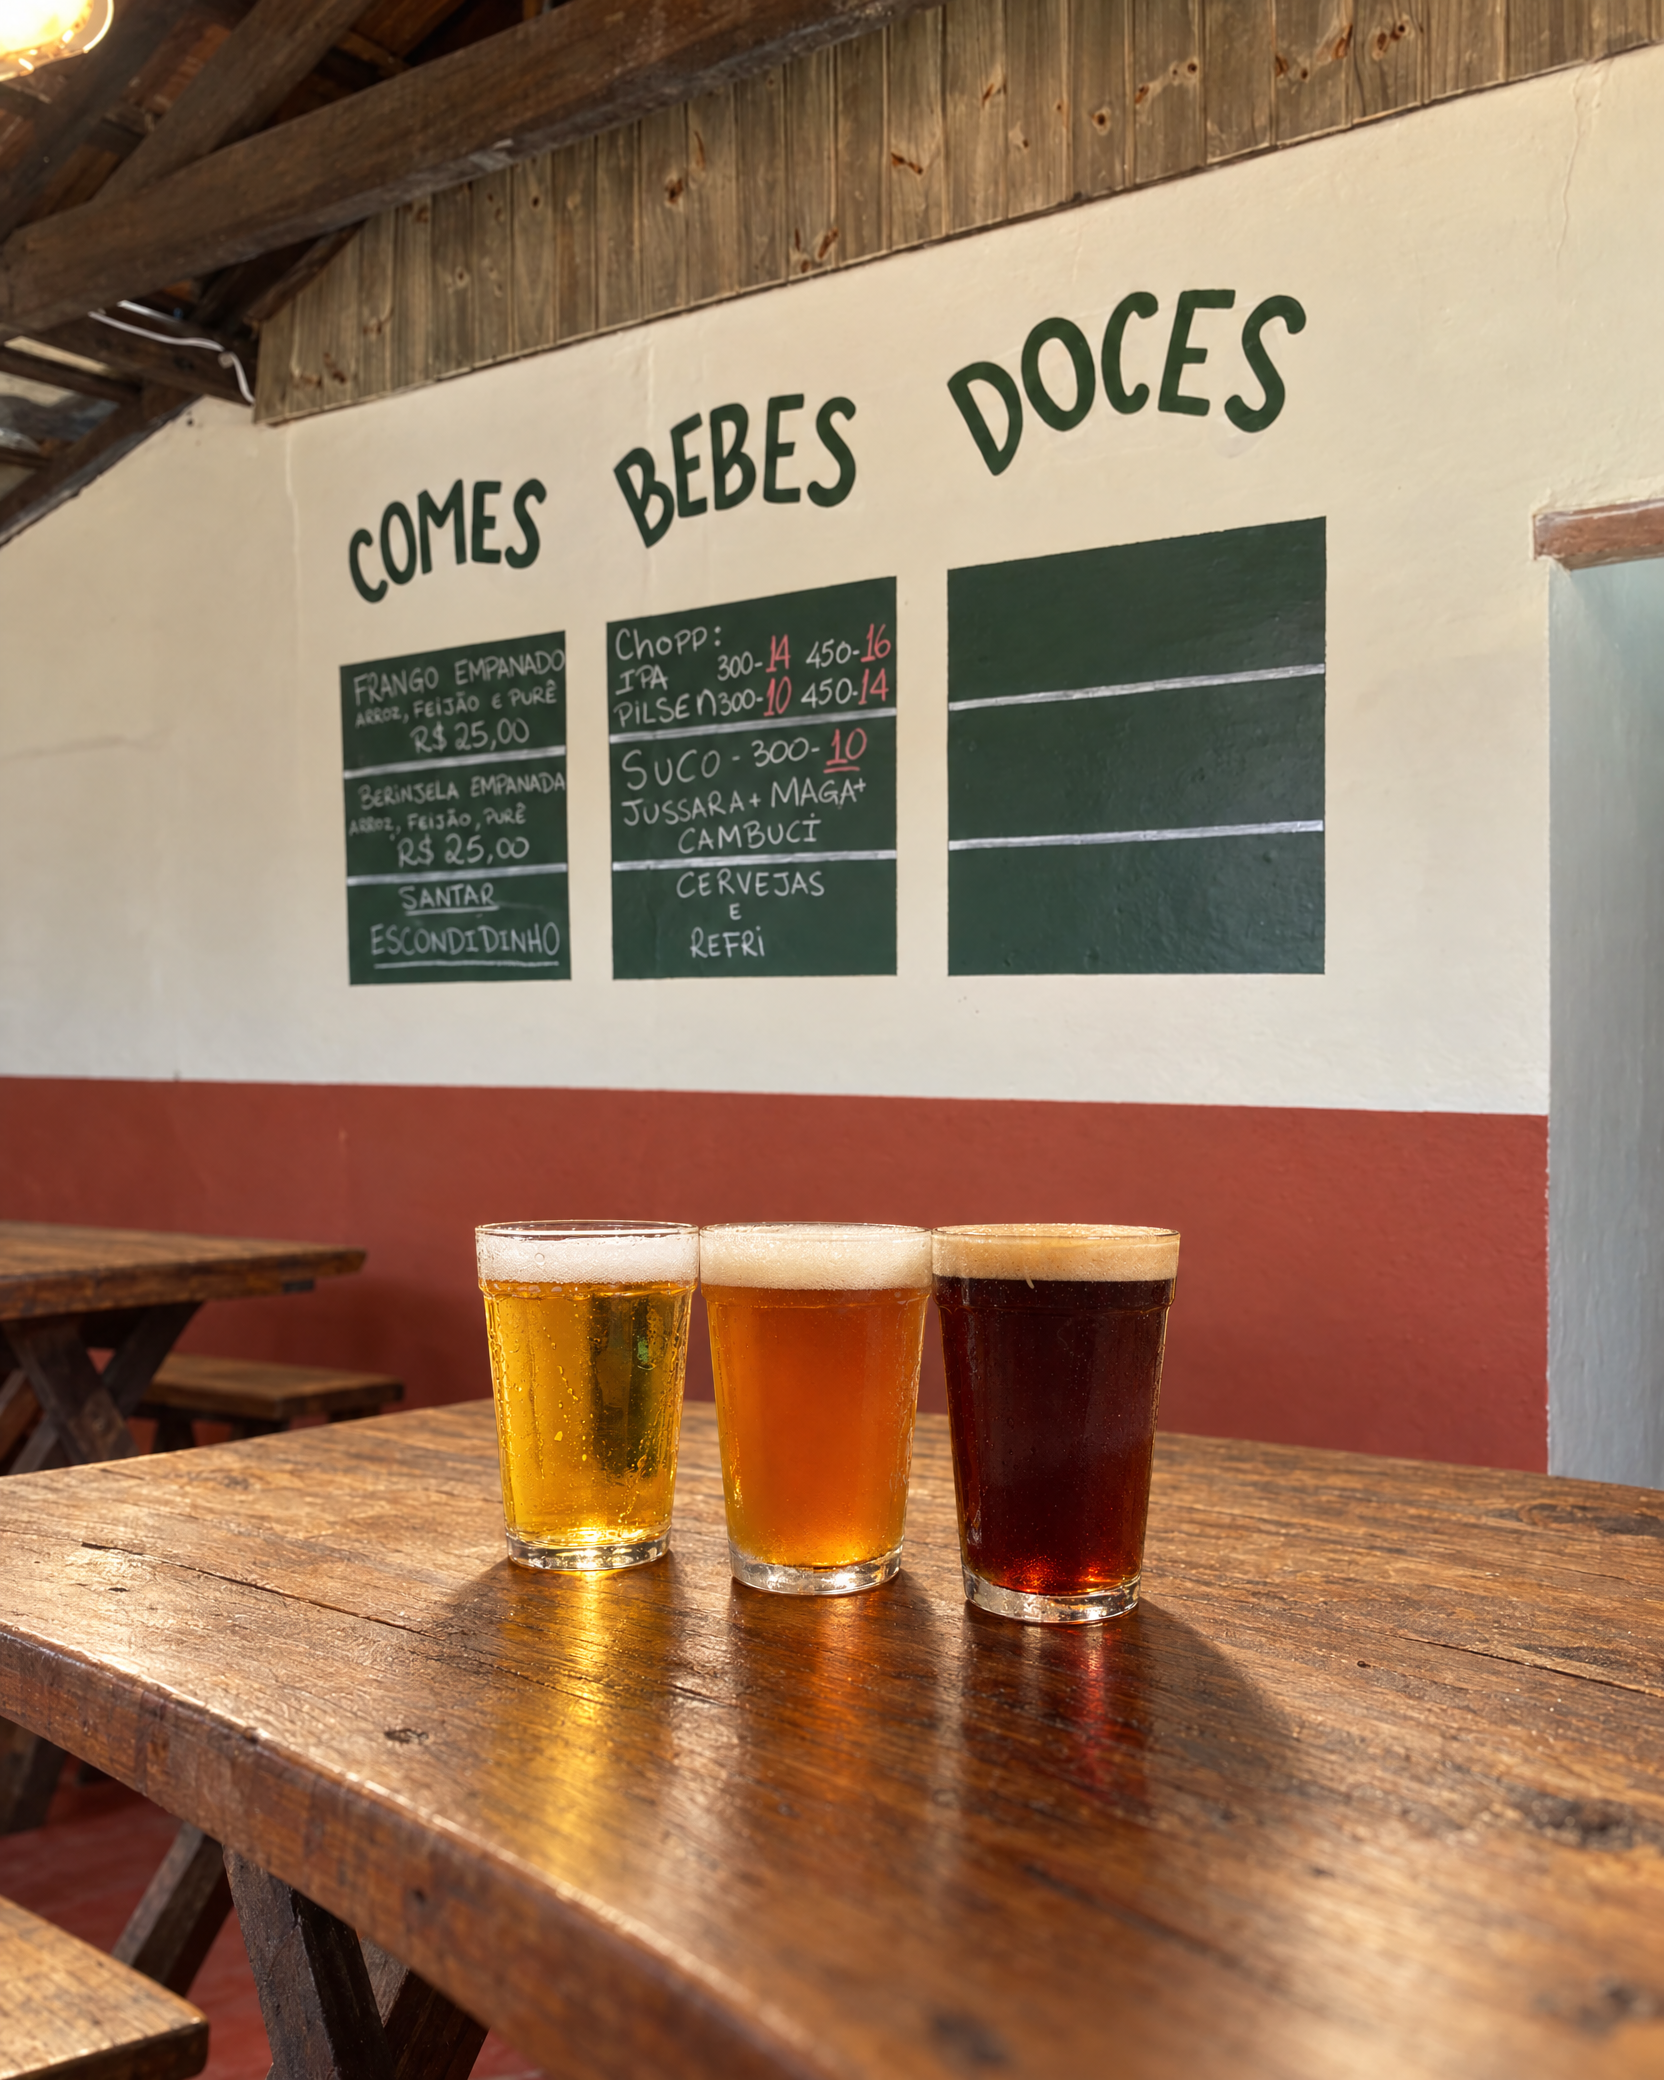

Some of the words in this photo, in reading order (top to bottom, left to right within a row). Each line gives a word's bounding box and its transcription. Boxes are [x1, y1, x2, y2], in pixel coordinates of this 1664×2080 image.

[947, 289, 1308, 477] DOCES
[613, 393, 857, 548] BEBES
[349, 479, 547, 604] COMES
[353, 667, 439, 706] FRANGO
[454, 649, 565, 685] EMPANADO
[508, 679, 558, 708] PURÊ
[614, 664, 669, 696] IPA
[409, 721, 448, 753] R$
[454, 717, 530, 752] 25,00
[470, 772, 566, 798] EMPANADA
[621, 749, 721, 791] SUCO
[397, 833, 435, 868] R$
[444, 832, 530, 865] 25,00
[398, 882, 497, 911] SANTAR
[676, 867, 826, 899] CERVEJAS
[729, 902, 742, 921] E
[370, 921, 560, 957] ESCONDIDINHO
